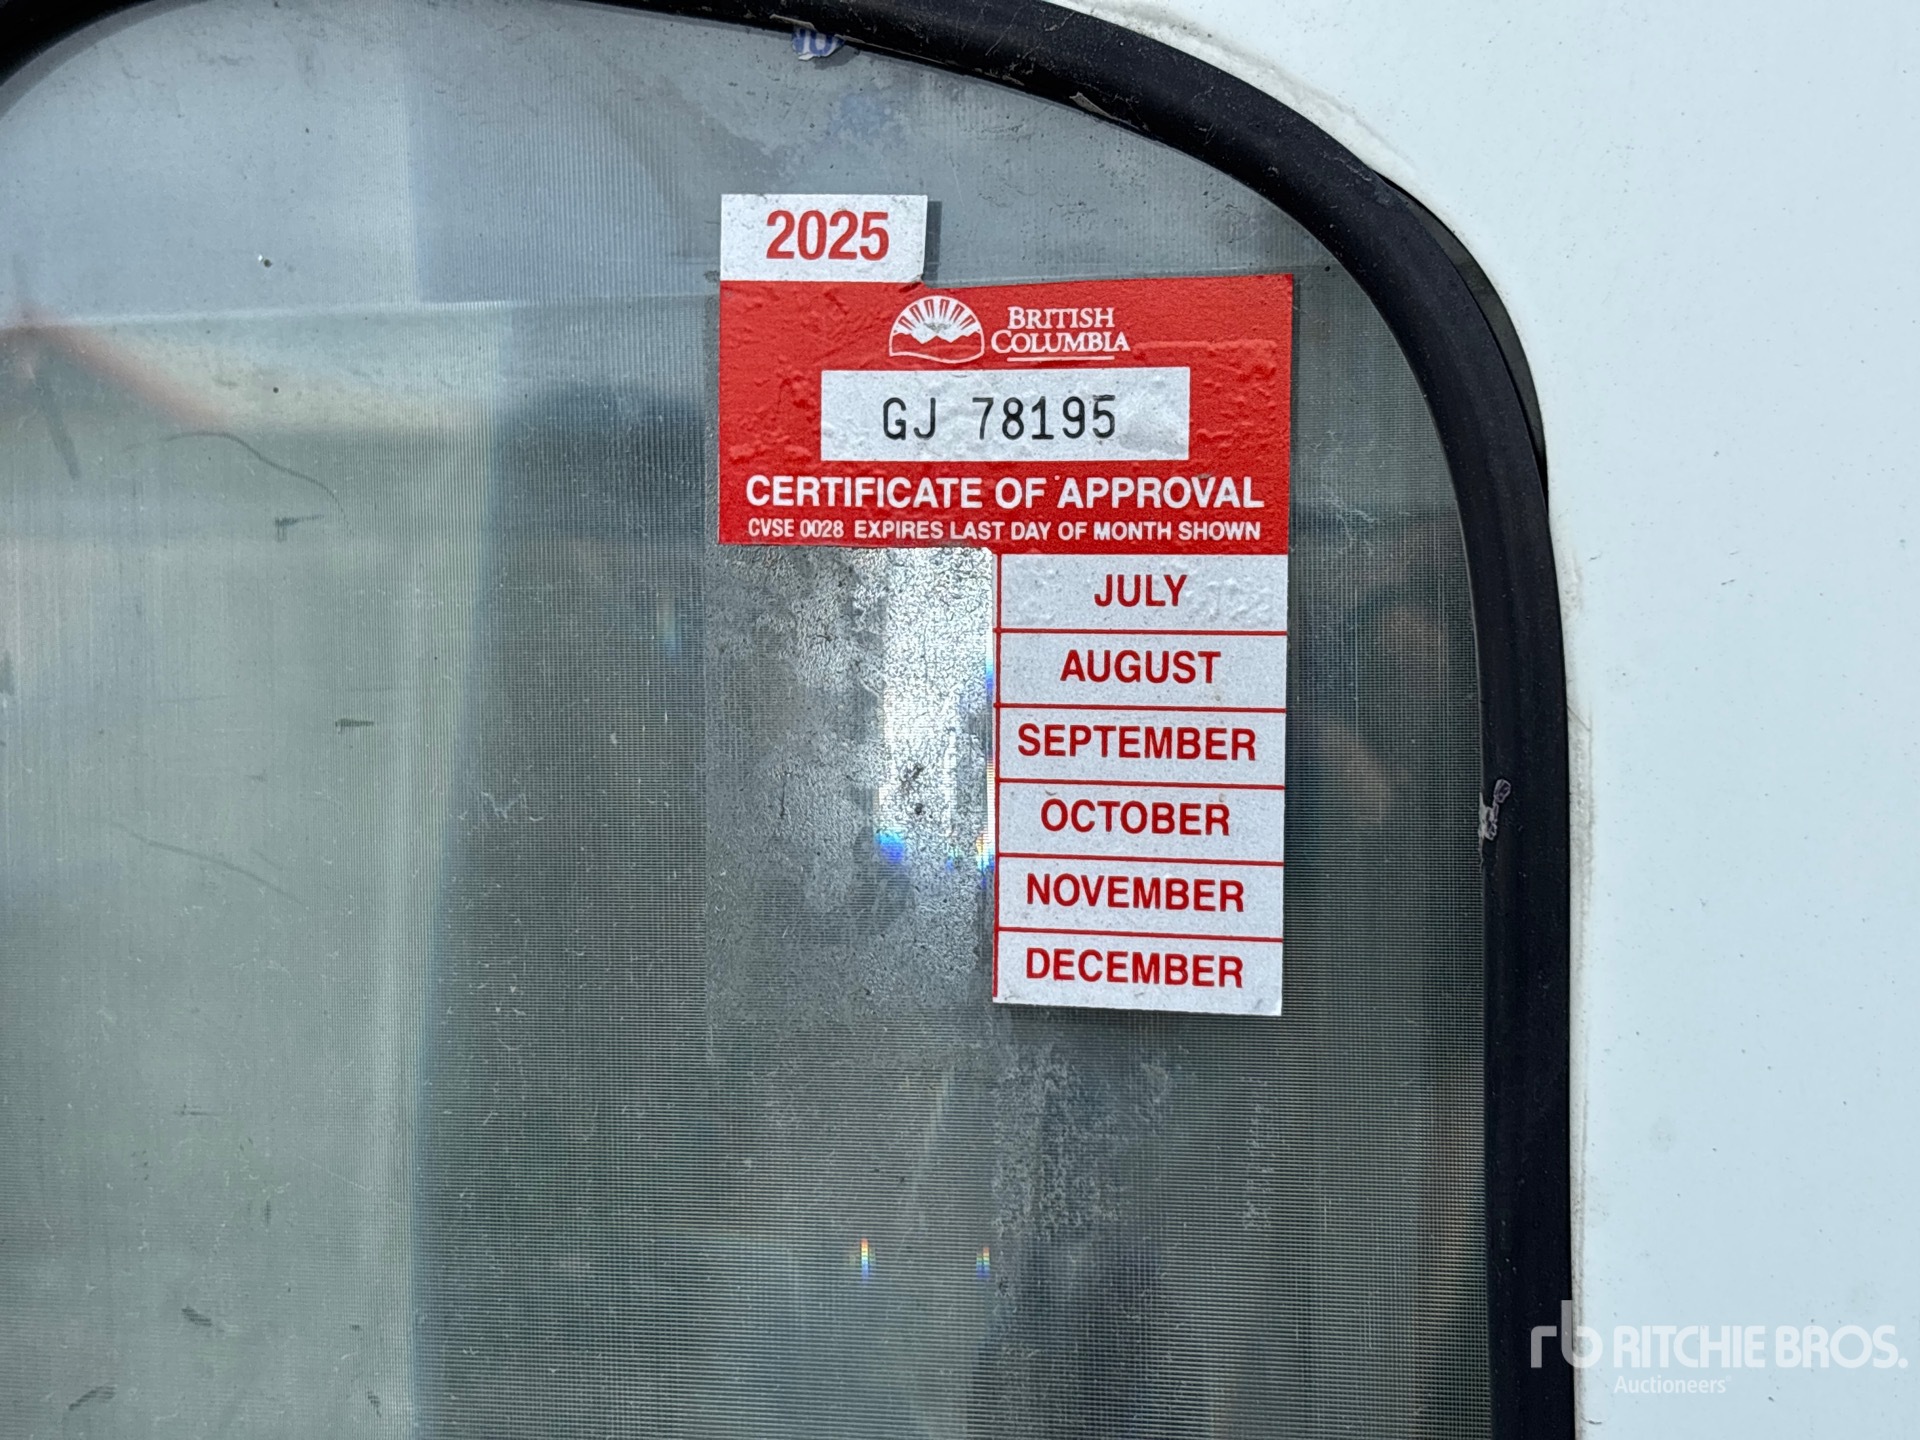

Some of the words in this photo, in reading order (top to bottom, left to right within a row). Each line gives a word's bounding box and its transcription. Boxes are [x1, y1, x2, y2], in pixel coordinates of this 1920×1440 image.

[766, 210, 890, 261] 2025
[1007, 306, 1115, 330] BRITISH
[990, 329, 1131, 354] COLUMBIA
[882, 397, 937, 440] GJ
[972, 395, 1117, 440] 78195
[745, 475, 983, 509] CERTIFICATE
[994, 476, 1047, 509] OF
[1057, 476, 1265, 509] APPROVAL
[748, 518, 795, 538] CVSE
[799, 520, 844, 539] 0028
[854, 520, 944, 540] EXPIRES
[949, 521, 1004, 541] LAST
[1009, 521, 1051, 541] DAY
[1057, 521, 1089, 541] OF
[1093, 521, 1172, 541] MONTH
[1177, 521, 1261, 541] SHOWN
[1094, 574, 1188, 607] JULY
[1060, 649, 1222, 684] AUGUST
[1017, 723, 1257, 761] SEPTEMBER
[1040, 798, 1230, 836] OCTOBER
[1026, 872, 1244, 913] NOVEMBER
[1026, 947, 1244, 988] DECEMBER
